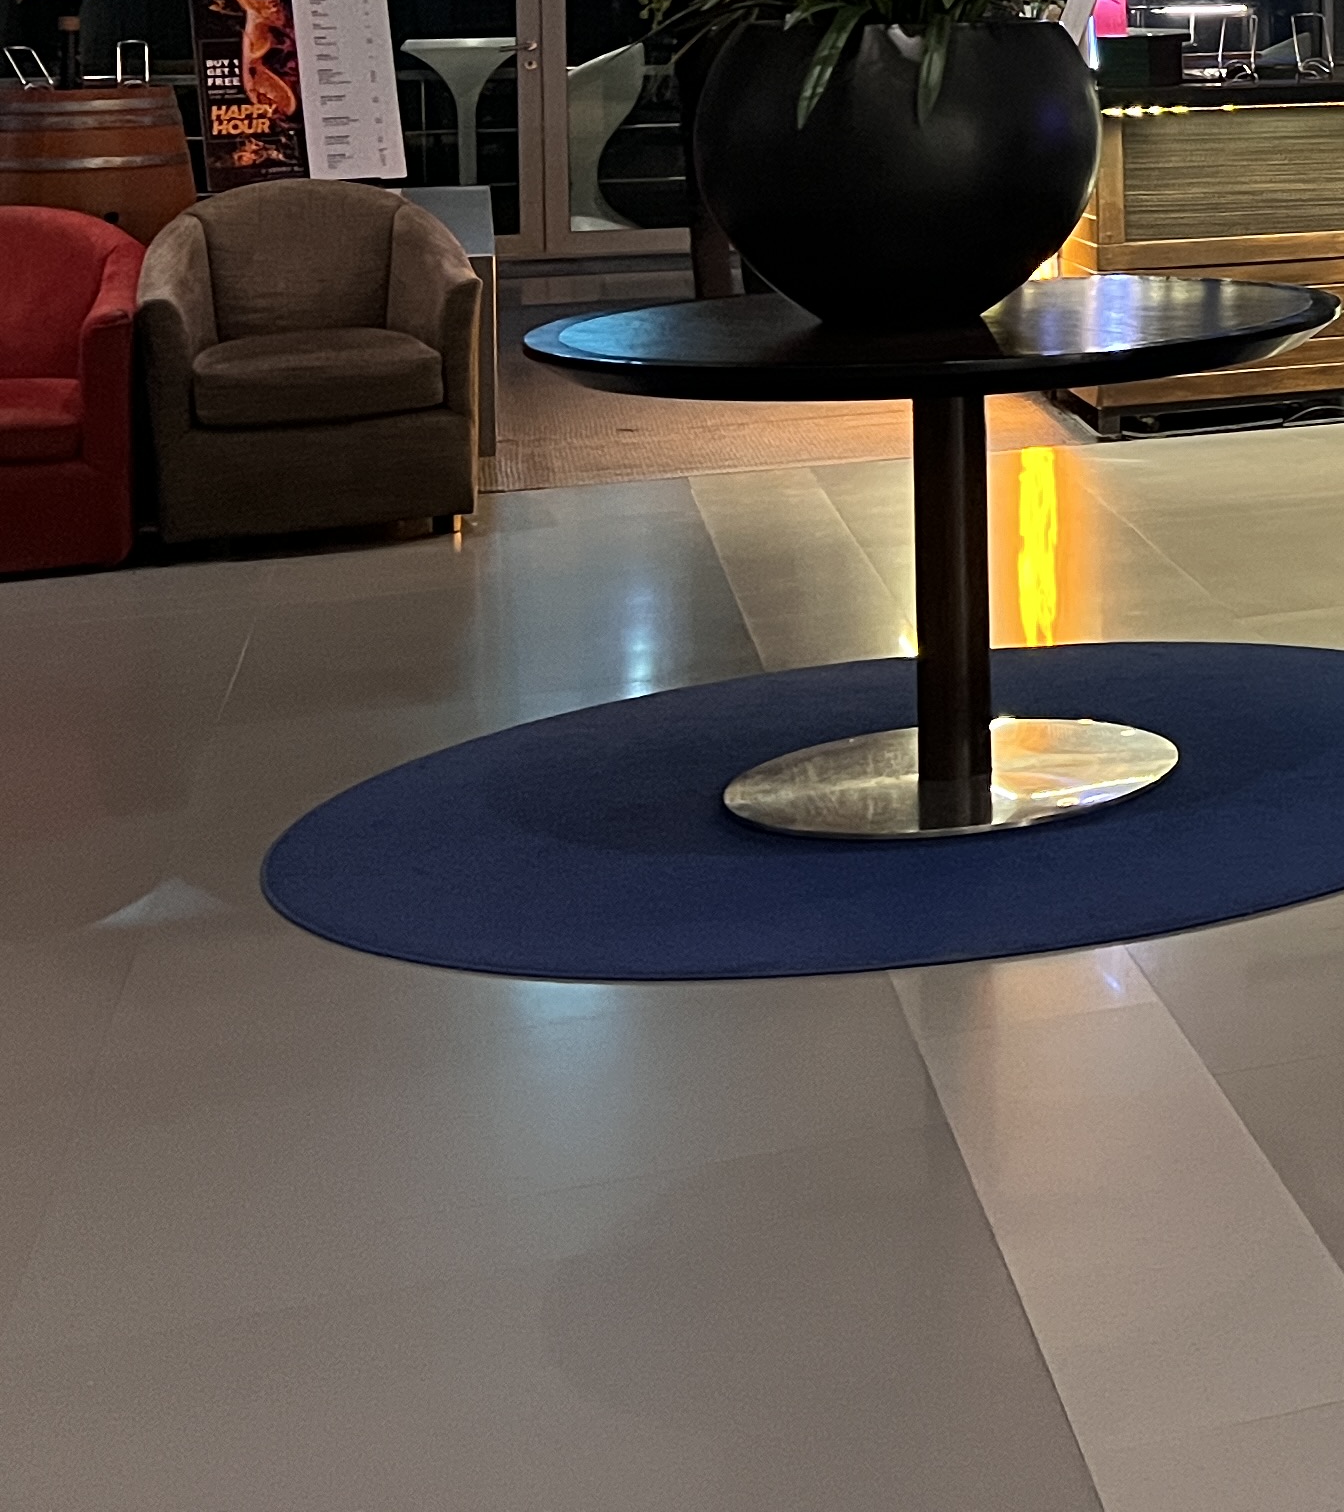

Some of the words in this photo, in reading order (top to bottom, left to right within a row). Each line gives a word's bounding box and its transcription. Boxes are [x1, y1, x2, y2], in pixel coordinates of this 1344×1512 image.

[206, 59, 230, 68] BUY
[207, 68, 230, 76] GET
[207, 77, 241, 86] FREE
[211, 104, 277, 120] HAPPY
[212, 119, 271, 136] HOUR
